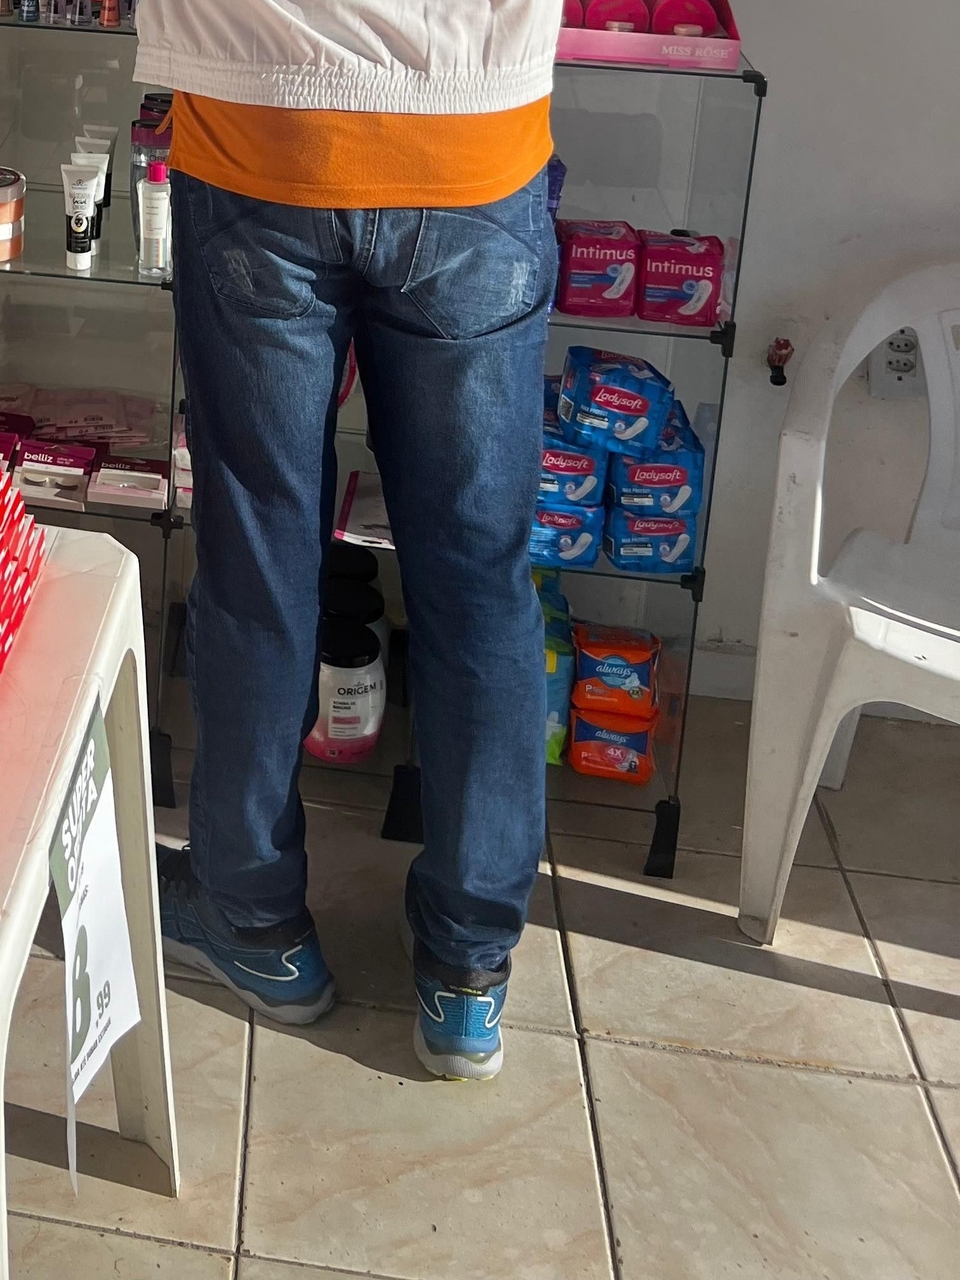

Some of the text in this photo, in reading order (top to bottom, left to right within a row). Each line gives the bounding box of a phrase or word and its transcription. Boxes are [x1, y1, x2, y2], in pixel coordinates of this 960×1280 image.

[661, 45, 691, 57] MISS
[571, 244, 636, 260] Intimus
[646, 258, 714, 278] Intimus
[595, 388, 643, 410] Ladysoft
[23, 451, 54, 463] belliz
[541, 452, 589, 470] Ladysoft
[101, 462, 131, 470] belliz
[634, 469, 682, 482] Ladysoft
[633, 519, 680, 531] Ladysoft
[595, 664, 632, 678] always
[337, 682, 377, 696] ORIGEM
[595, 729, 628, 744] always
[62, 738, 95, 860] SUPER
